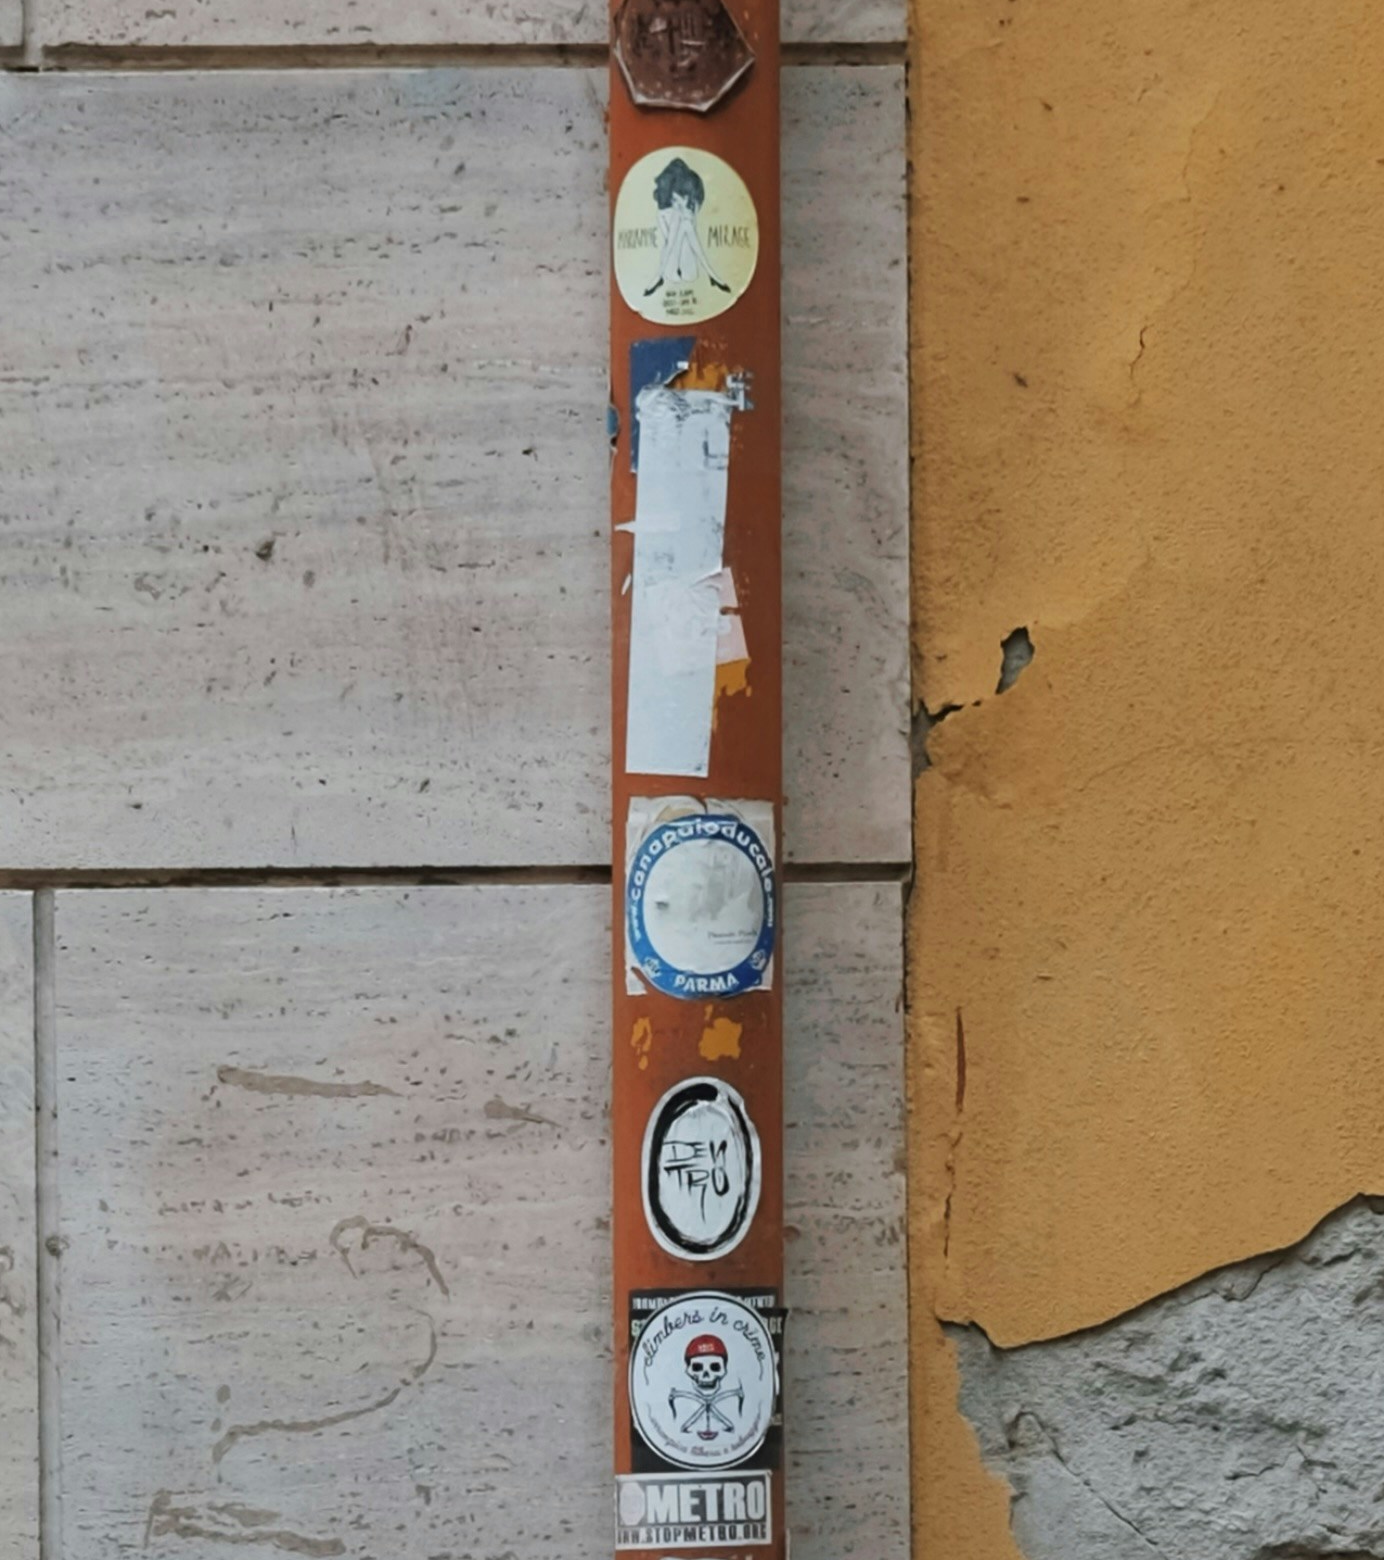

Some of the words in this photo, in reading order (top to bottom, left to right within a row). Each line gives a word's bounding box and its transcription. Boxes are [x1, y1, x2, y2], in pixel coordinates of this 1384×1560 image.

[673, 972, 740, 991] PARMA
[642, 1309, 704, 1367] climbers
[709, 1306, 728, 1326] in
[733, 1318, 766, 1362] crime
[646, 1480, 765, 1524] METRO
